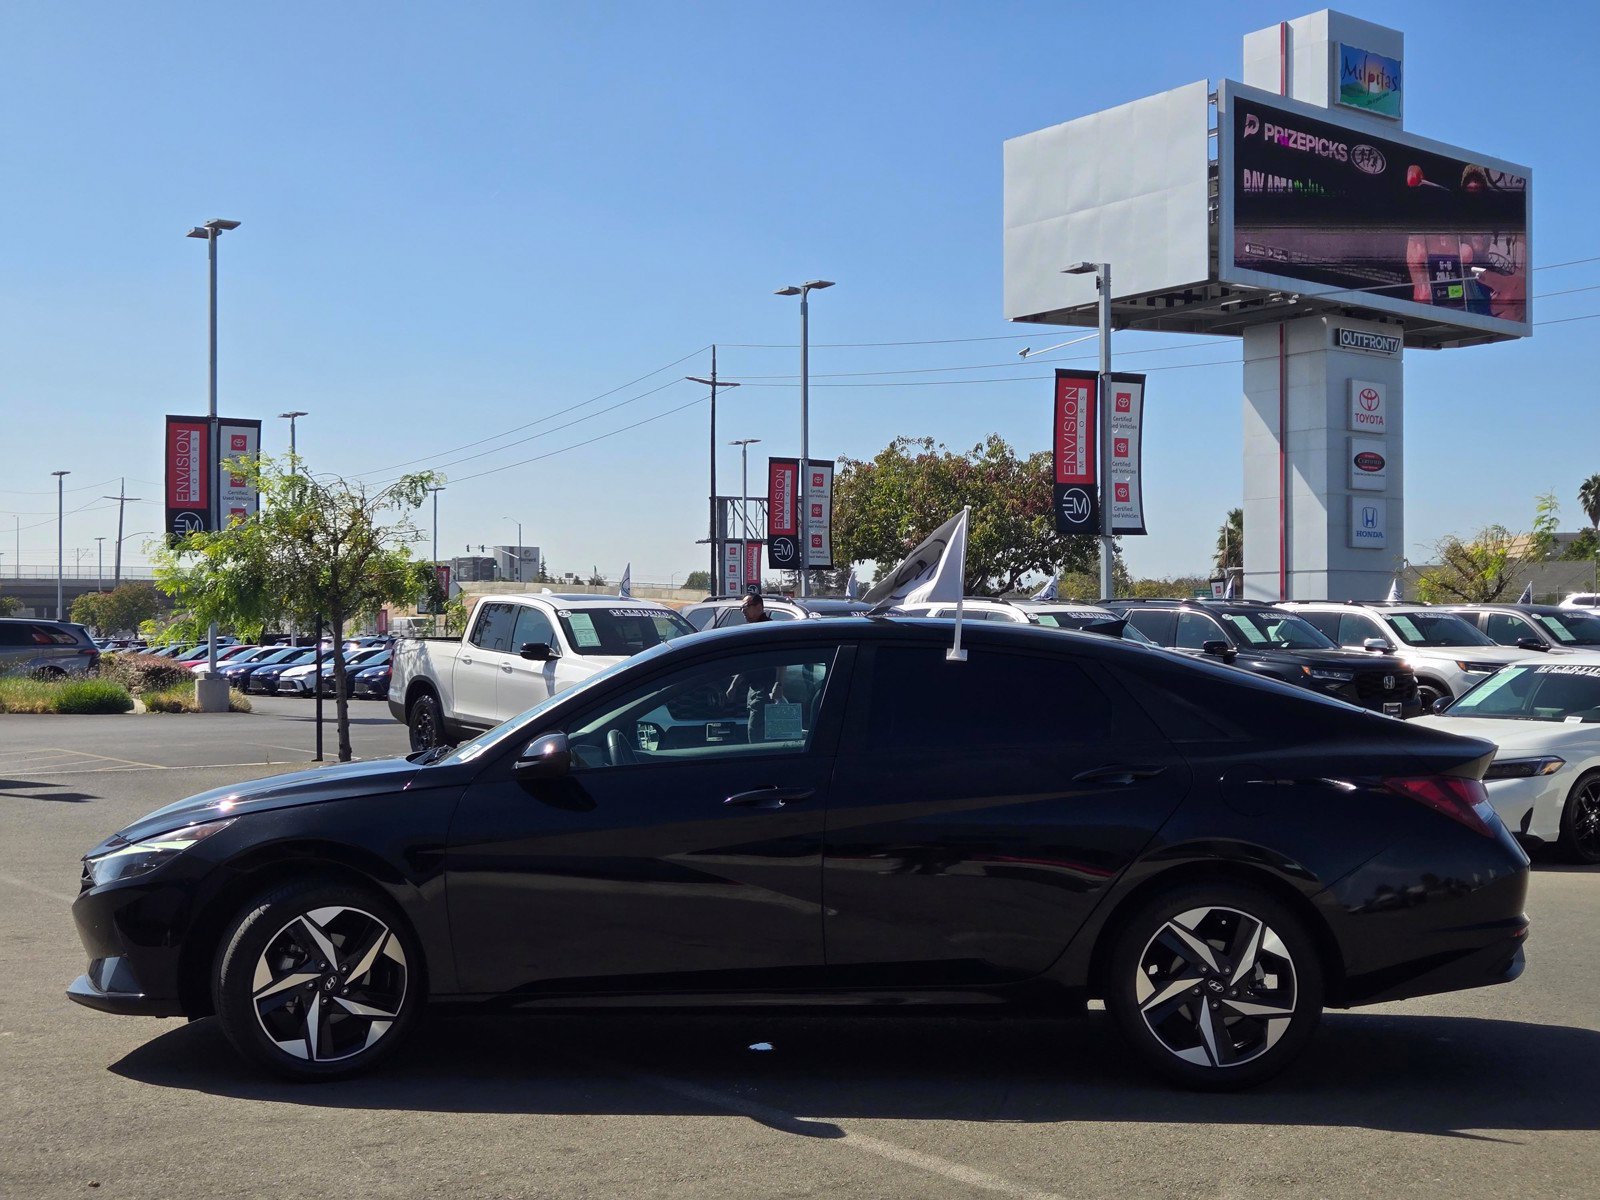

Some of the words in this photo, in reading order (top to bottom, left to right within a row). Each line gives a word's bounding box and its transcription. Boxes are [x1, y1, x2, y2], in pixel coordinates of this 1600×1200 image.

[1341, 54, 1398, 97] Milpitas
[1264, 122, 1348, 162] PRIZEPICKS
[1064, 386, 1078, 475] ENVISION
[1078, 395, 1087, 468] MOTORS
[1354, 412, 1385, 426] TOYOTA
[176, 429, 190, 502] ENVISION
[191, 437, 199, 496] MOTORS
[775, 469, 785, 530] ENVISION
[1356, 530, 1384, 538] HONDA
[620, 609, 669, 618] CERTIFIED
